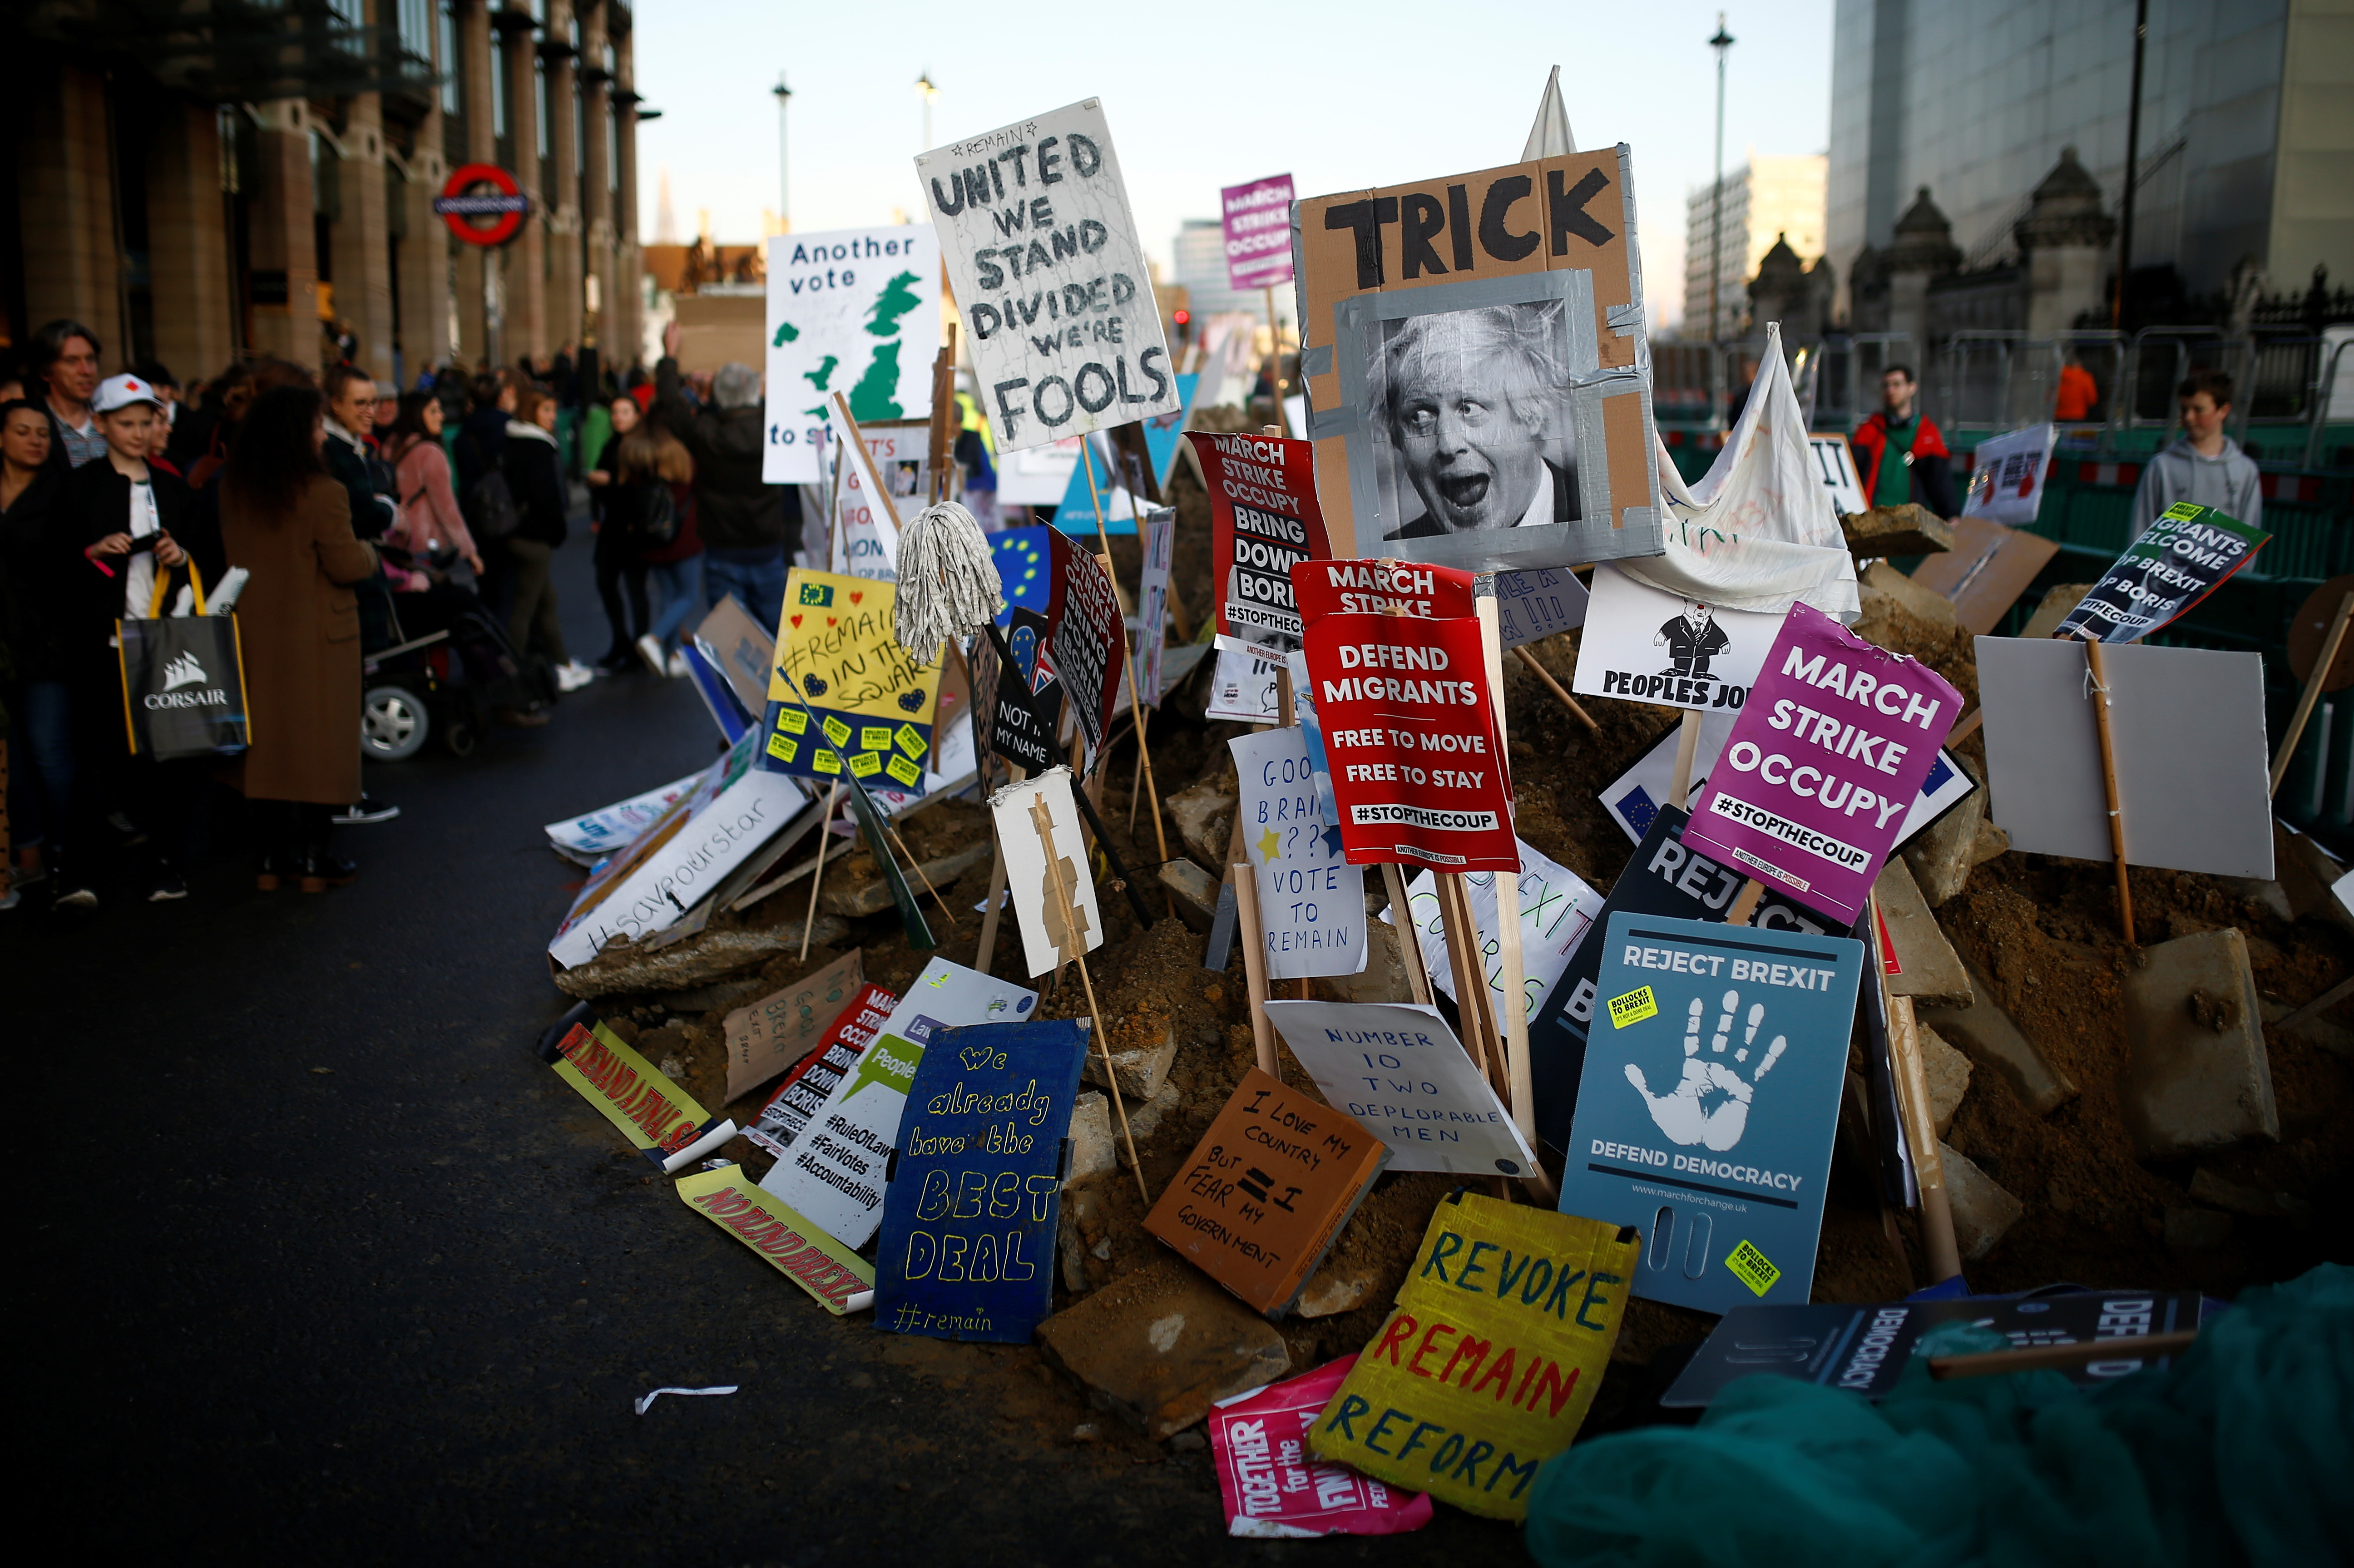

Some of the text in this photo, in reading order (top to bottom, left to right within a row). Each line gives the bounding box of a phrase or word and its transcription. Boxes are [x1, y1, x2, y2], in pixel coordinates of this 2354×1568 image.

[967, 126, 1023, 156] REMAIN
[931, 133, 1102, 216] UNITED
[994, 196, 1053, 237] WE
[1324, 168, 1615, 290] TRICK
[791, 237, 915, 266] Another
[974, 219, 1108, 290] STAND
[790, 269, 856, 295] vote
[970, 272, 1136, 340] DIVIDED
[1032, 316, 1124, 357] WE'RE
[994, 346, 1167, 441] FOOLS
[770, 423, 796, 445] to
[1213, 436, 1284, 466] MARCH
[1221, 457, 1286, 490] STRIKE
[1222, 479, 1299, 515] OCCUPY
[1234, 505, 1305, 544] BRING
[2140, 531, 2230, 570] ELCOME
[1067, 539, 1116, 613] MARCH
[1071, 554, 1112, 627] STRIKE
[1241, 572, 1297, 608] BORI
[1327, 566, 1435, 595] MARCH
[2137, 557, 2206, 592] BREXIT
[1065, 564, 1115, 649] OCCUPY
[1340, 592, 1432, 617] STRIKE
[2081, 599, 2149, 626] PTHECOUP
[2115, 579, 2180, 611] BORIS
[1067, 585, 1106, 664] BRING
[1064, 607, 1103, 691] DOWN
[1246, 646, 1265, 658] ANOTHER
[1266, 652, 1281, 663] EUROPE
[1339, 644, 1449, 671] DEFEND
[832, 654, 865, 688] IN
[1063, 632, 1098, 707] BORIS
[1603, 670, 1710, 705] PEOPLE'S
[1780, 645, 1941, 730] MARCH
[144, 688, 228, 710] CORSAIR
[1053, 641, 1101, 740] #STOPTHECOUP
[1322, 677, 1478, 706] MIGRANTS
[999, 701, 1031, 730] NOT
[997, 727, 1047, 763] MY NAME
[1332, 728, 1486, 753] FREE TO MOVE
[1767, 699, 1909, 776] STRIKE
[1263, 757, 1312, 787] GOO
[1346, 764, 1484, 789] FREE TO STAY
[1728, 741, 1906, 830] OCCUPY
[1357, 806, 1492, 828] #STOPTHECOUP
[1717, 798, 1865, 867] #STOPTHECOUP
[1397, 845, 1418, 856] ANOTHER
[1418, 849, 1435, 860] EUROPE
[1440, 854, 1464, 863] POSSIBLE
[1734, 850, 1809, 890] ANOTHER EUROPE IS POSSIBLE
[1273, 865, 1337, 895] VOTE
[1290, 902, 1318, 923] TO
[1268, 926, 1348, 953] REMAIN
[1623, 945, 1835, 991] REJECT BREXIT
[1611, 989, 1647, 1008] BOLLOCKS
[1612, 996, 1650, 1015] TO BREXIT
[556, 1022, 593, 1061] WE
[1324, 1029, 1434, 1047] NUMBER
[573, 1038, 637, 1100] DEMAND
[822, 1044, 860, 1069] BRIN
[959, 1046, 1007, 1070] We
[928, 1079, 1050, 1125] already
[1362, 1077, 1438, 1095] TWO
[624, 1086, 682, 1142] FINAL
[1243, 1091, 1351, 1161] I LOVE MY
[1349, 1103, 1498, 1123] DEPLORABLE
[658, 1121, 702, 1156] SA
[825, 1113, 892, 1157] #RuleOfLaw
[909, 1122, 1034, 1156] have the
[1244, 1126, 1321, 1172] COUNTRY
[1393, 1126, 1459, 1143] MEN
[810, 1134, 870, 1176] #FairVotes
[1207, 1146, 1243, 1171] BUT
[1590, 1139, 1802, 1192] DEFEND DEMOCRACY
[794, 1153, 882, 1212] #Accountability
[916, 1169, 1058, 1222] BEST
[1184, 1165, 1265, 1225] FEAR MY
[1632, 1183, 1747, 1214] www.marchforchange.uk
[693, 1187, 752, 1215] NO
[718, 1206, 806, 1255] BLIND
[1177, 1205, 1281, 1270] GOVERNMENT
[1297, 1182, 1362, 1278] FRESHLY MADE JUST FOR YOU
[905, 1231, 1034, 1281] DEAL
[1736, 1249, 1747, 1261] TO
[1746, 1259, 1771, 1283] BREXIT
[1742, 1243, 1776, 1277] BOLLOCKS
[1421, 1232, 1626, 1331] REVOKE
[894, 1302, 993, 1332] #remain
[1373, 1315, 1580, 1418] REMAIN
[1838, 1308, 1909, 1389] DEMOCRACY
[1326, 1394, 1539, 1500] REFORM
[1230, 1418, 1282, 1516] TOGETHER
[1275, 1439, 1310, 1494] for the
